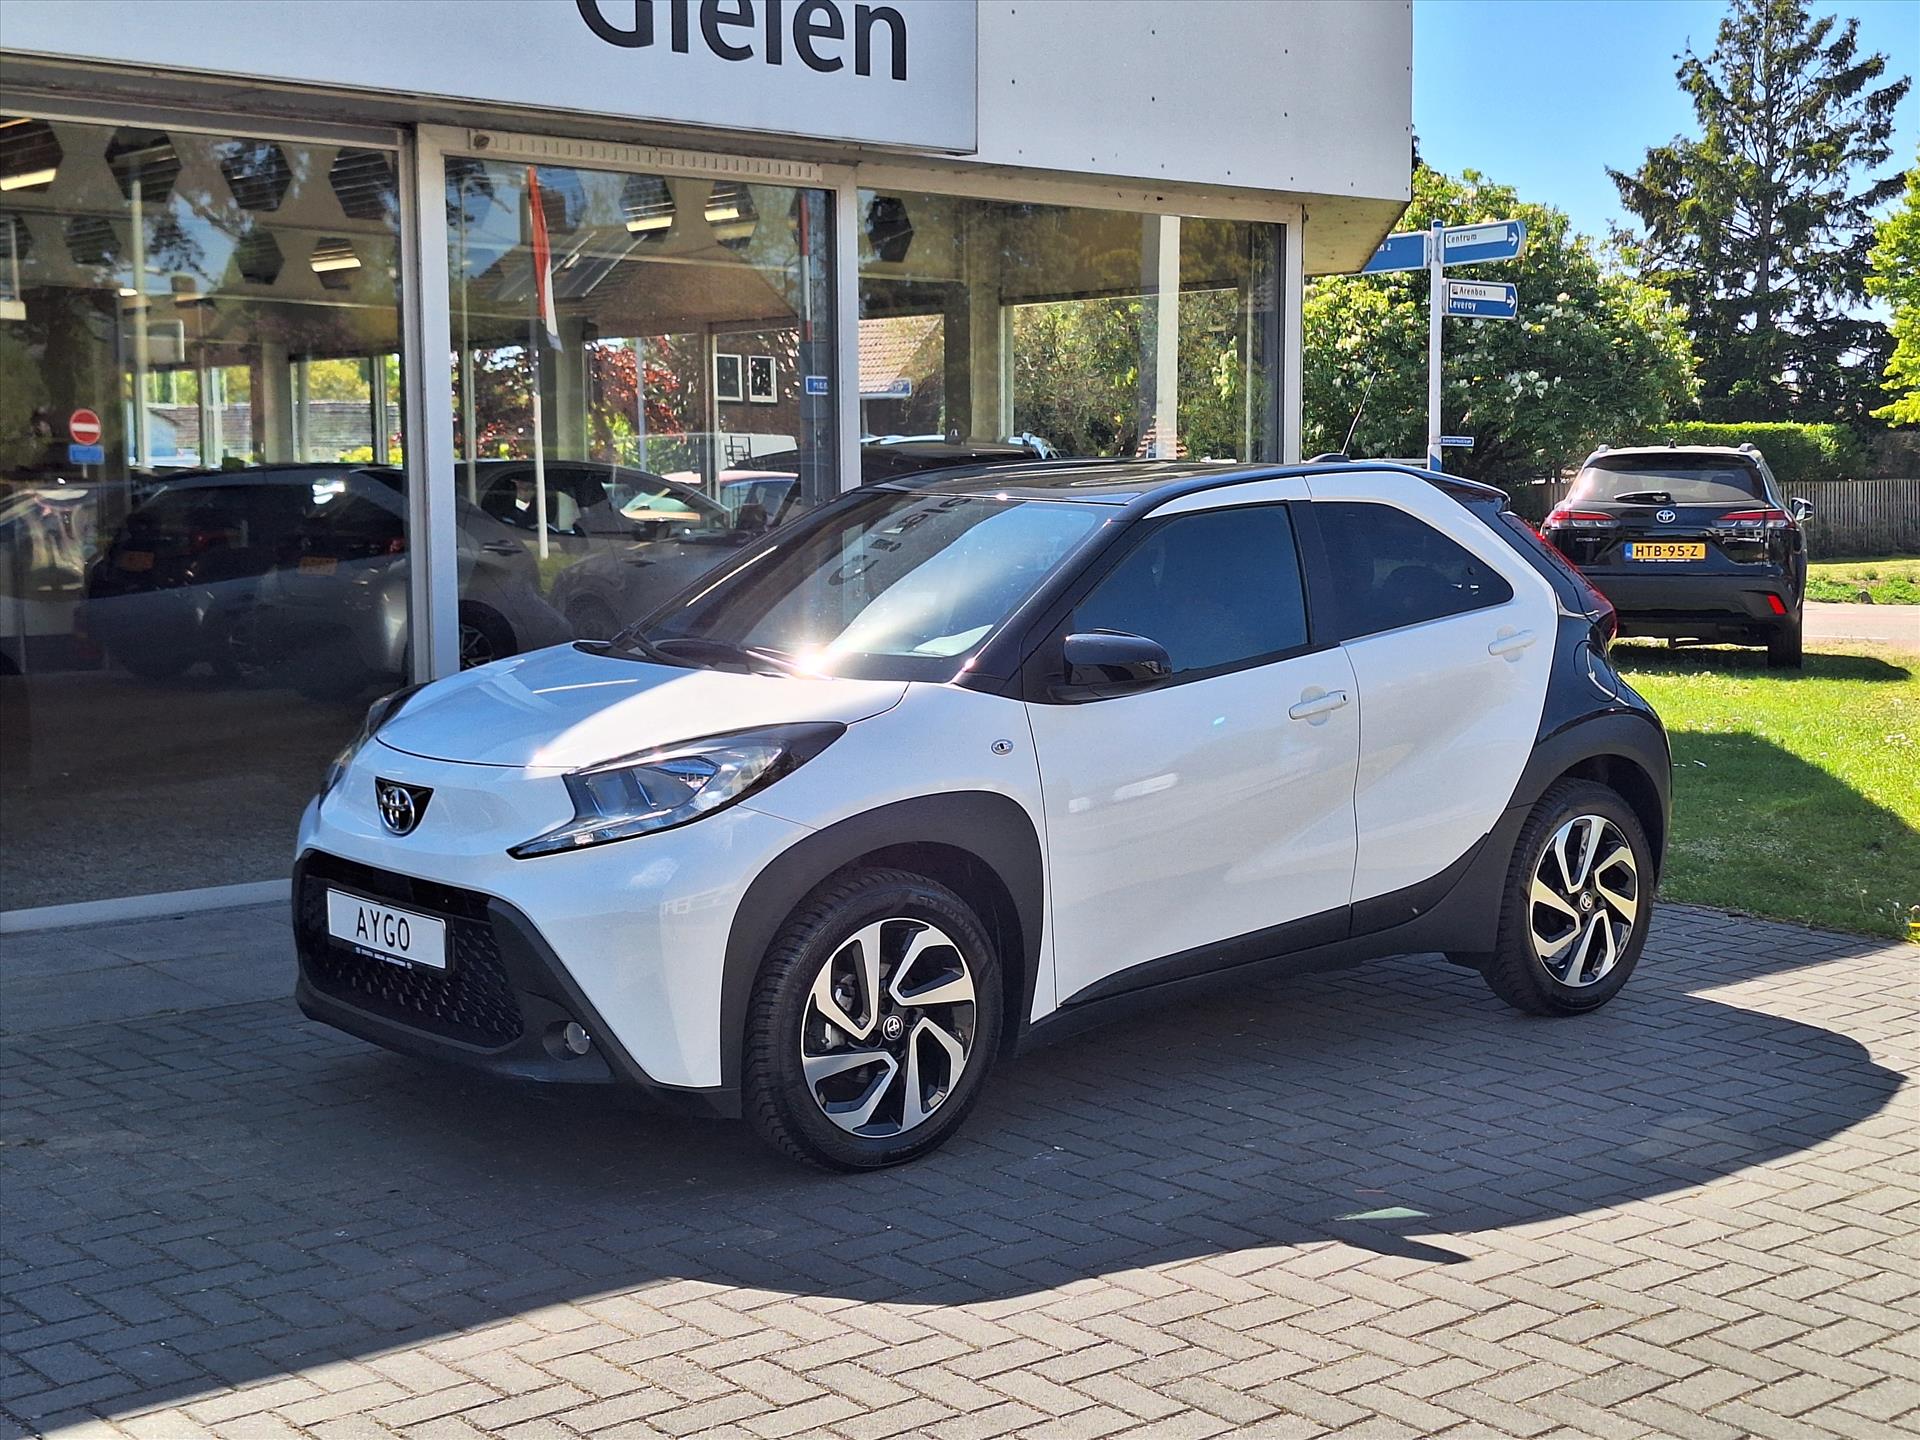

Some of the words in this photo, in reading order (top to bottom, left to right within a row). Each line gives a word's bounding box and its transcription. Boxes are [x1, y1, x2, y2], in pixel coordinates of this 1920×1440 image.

[1447, 233, 1477, 243] Centrum
[1459, 286, 1486, 296] Arenbos
[1449, 299, 1477, 312] Leveroy
[1635, 545, 1699, 557] HTB-95-Z
[356, 906, 411, 951] AYGO
